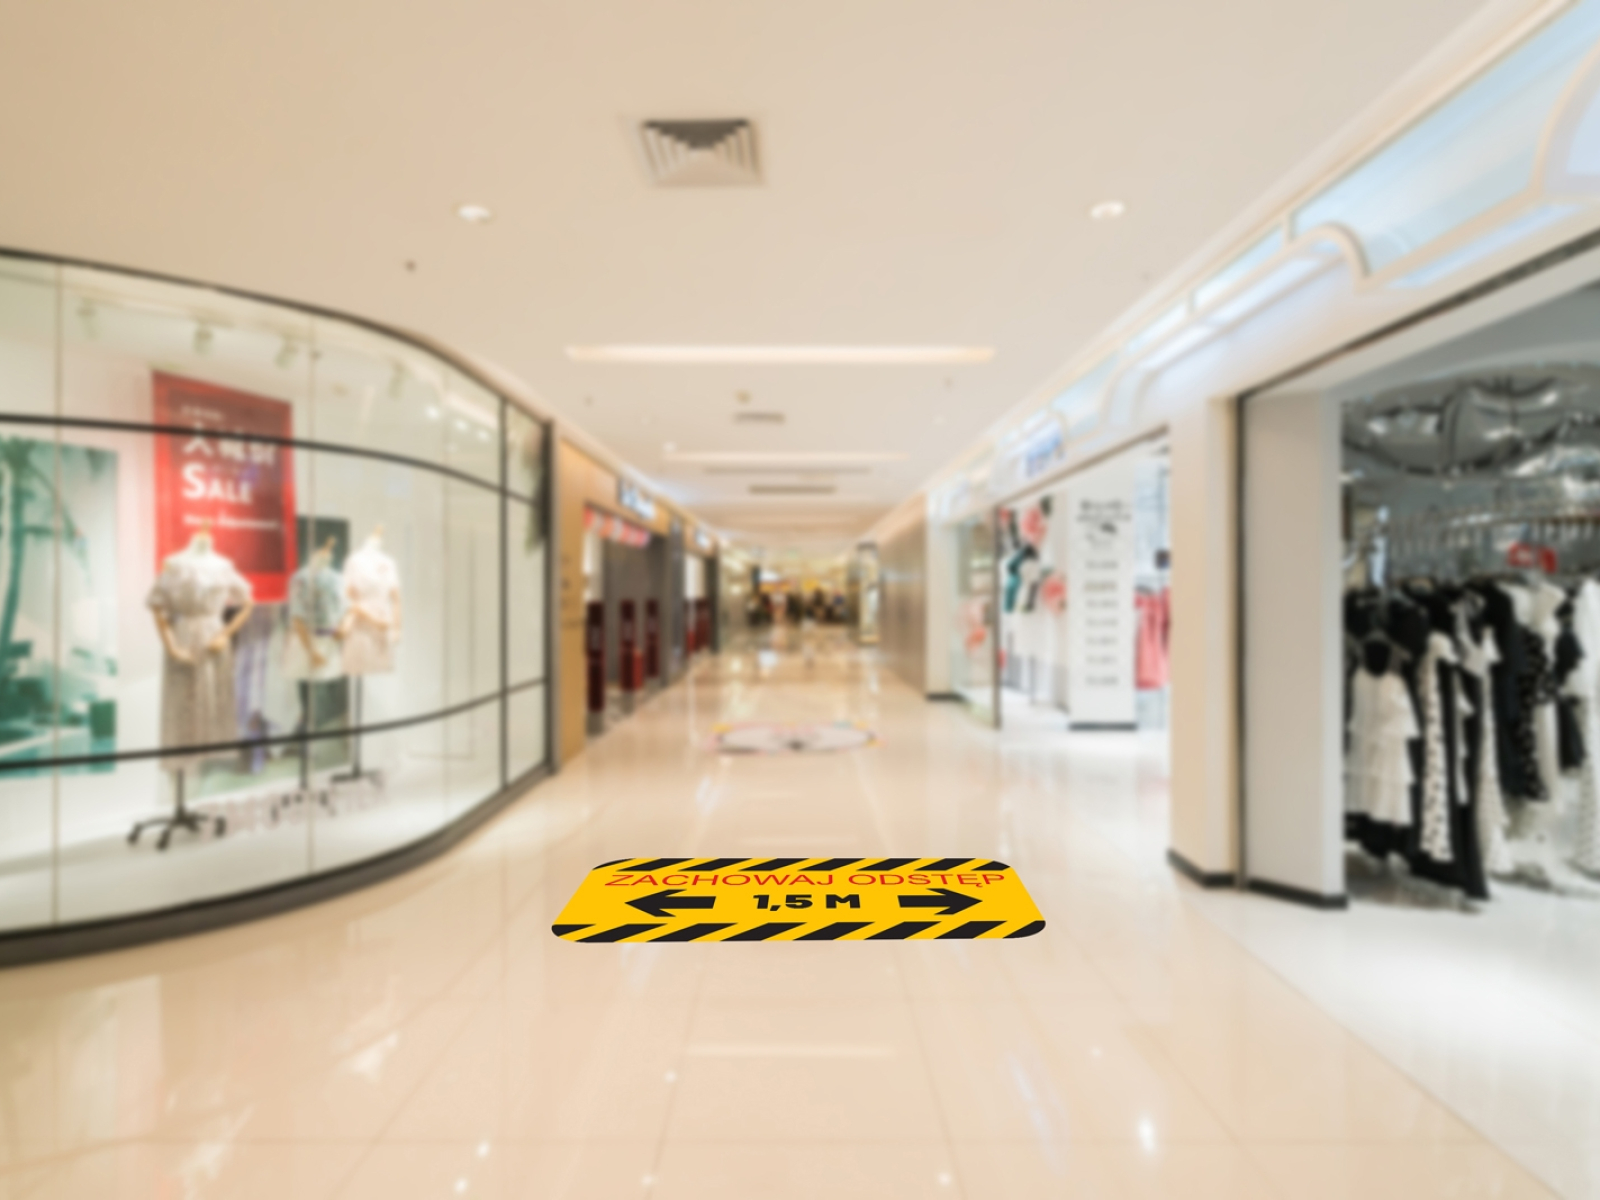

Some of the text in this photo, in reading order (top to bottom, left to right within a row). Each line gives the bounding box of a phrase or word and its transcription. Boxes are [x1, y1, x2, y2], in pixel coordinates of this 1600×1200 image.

[604, 873, 1005, 888] ZACHOWAJ ODSTĘP
[753, 894, 861, 912] 1,5 M
